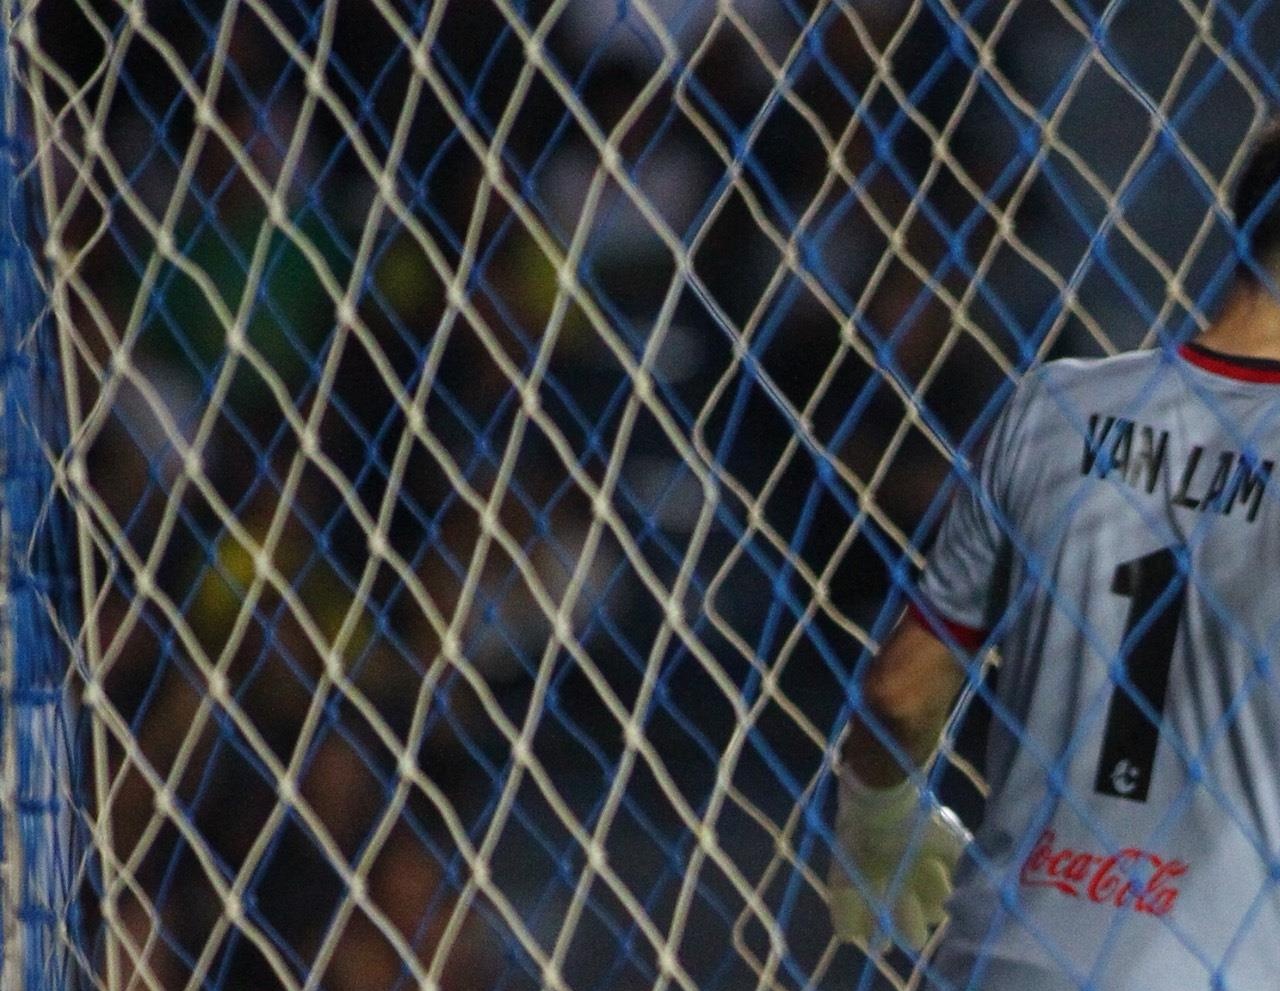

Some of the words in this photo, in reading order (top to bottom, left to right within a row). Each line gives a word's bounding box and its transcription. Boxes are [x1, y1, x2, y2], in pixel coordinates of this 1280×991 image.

[1081, 413, 1169, 494] VAN
[1172, 446, 1275, 523] LAM
[1094, 545, 1190, 804] 1
